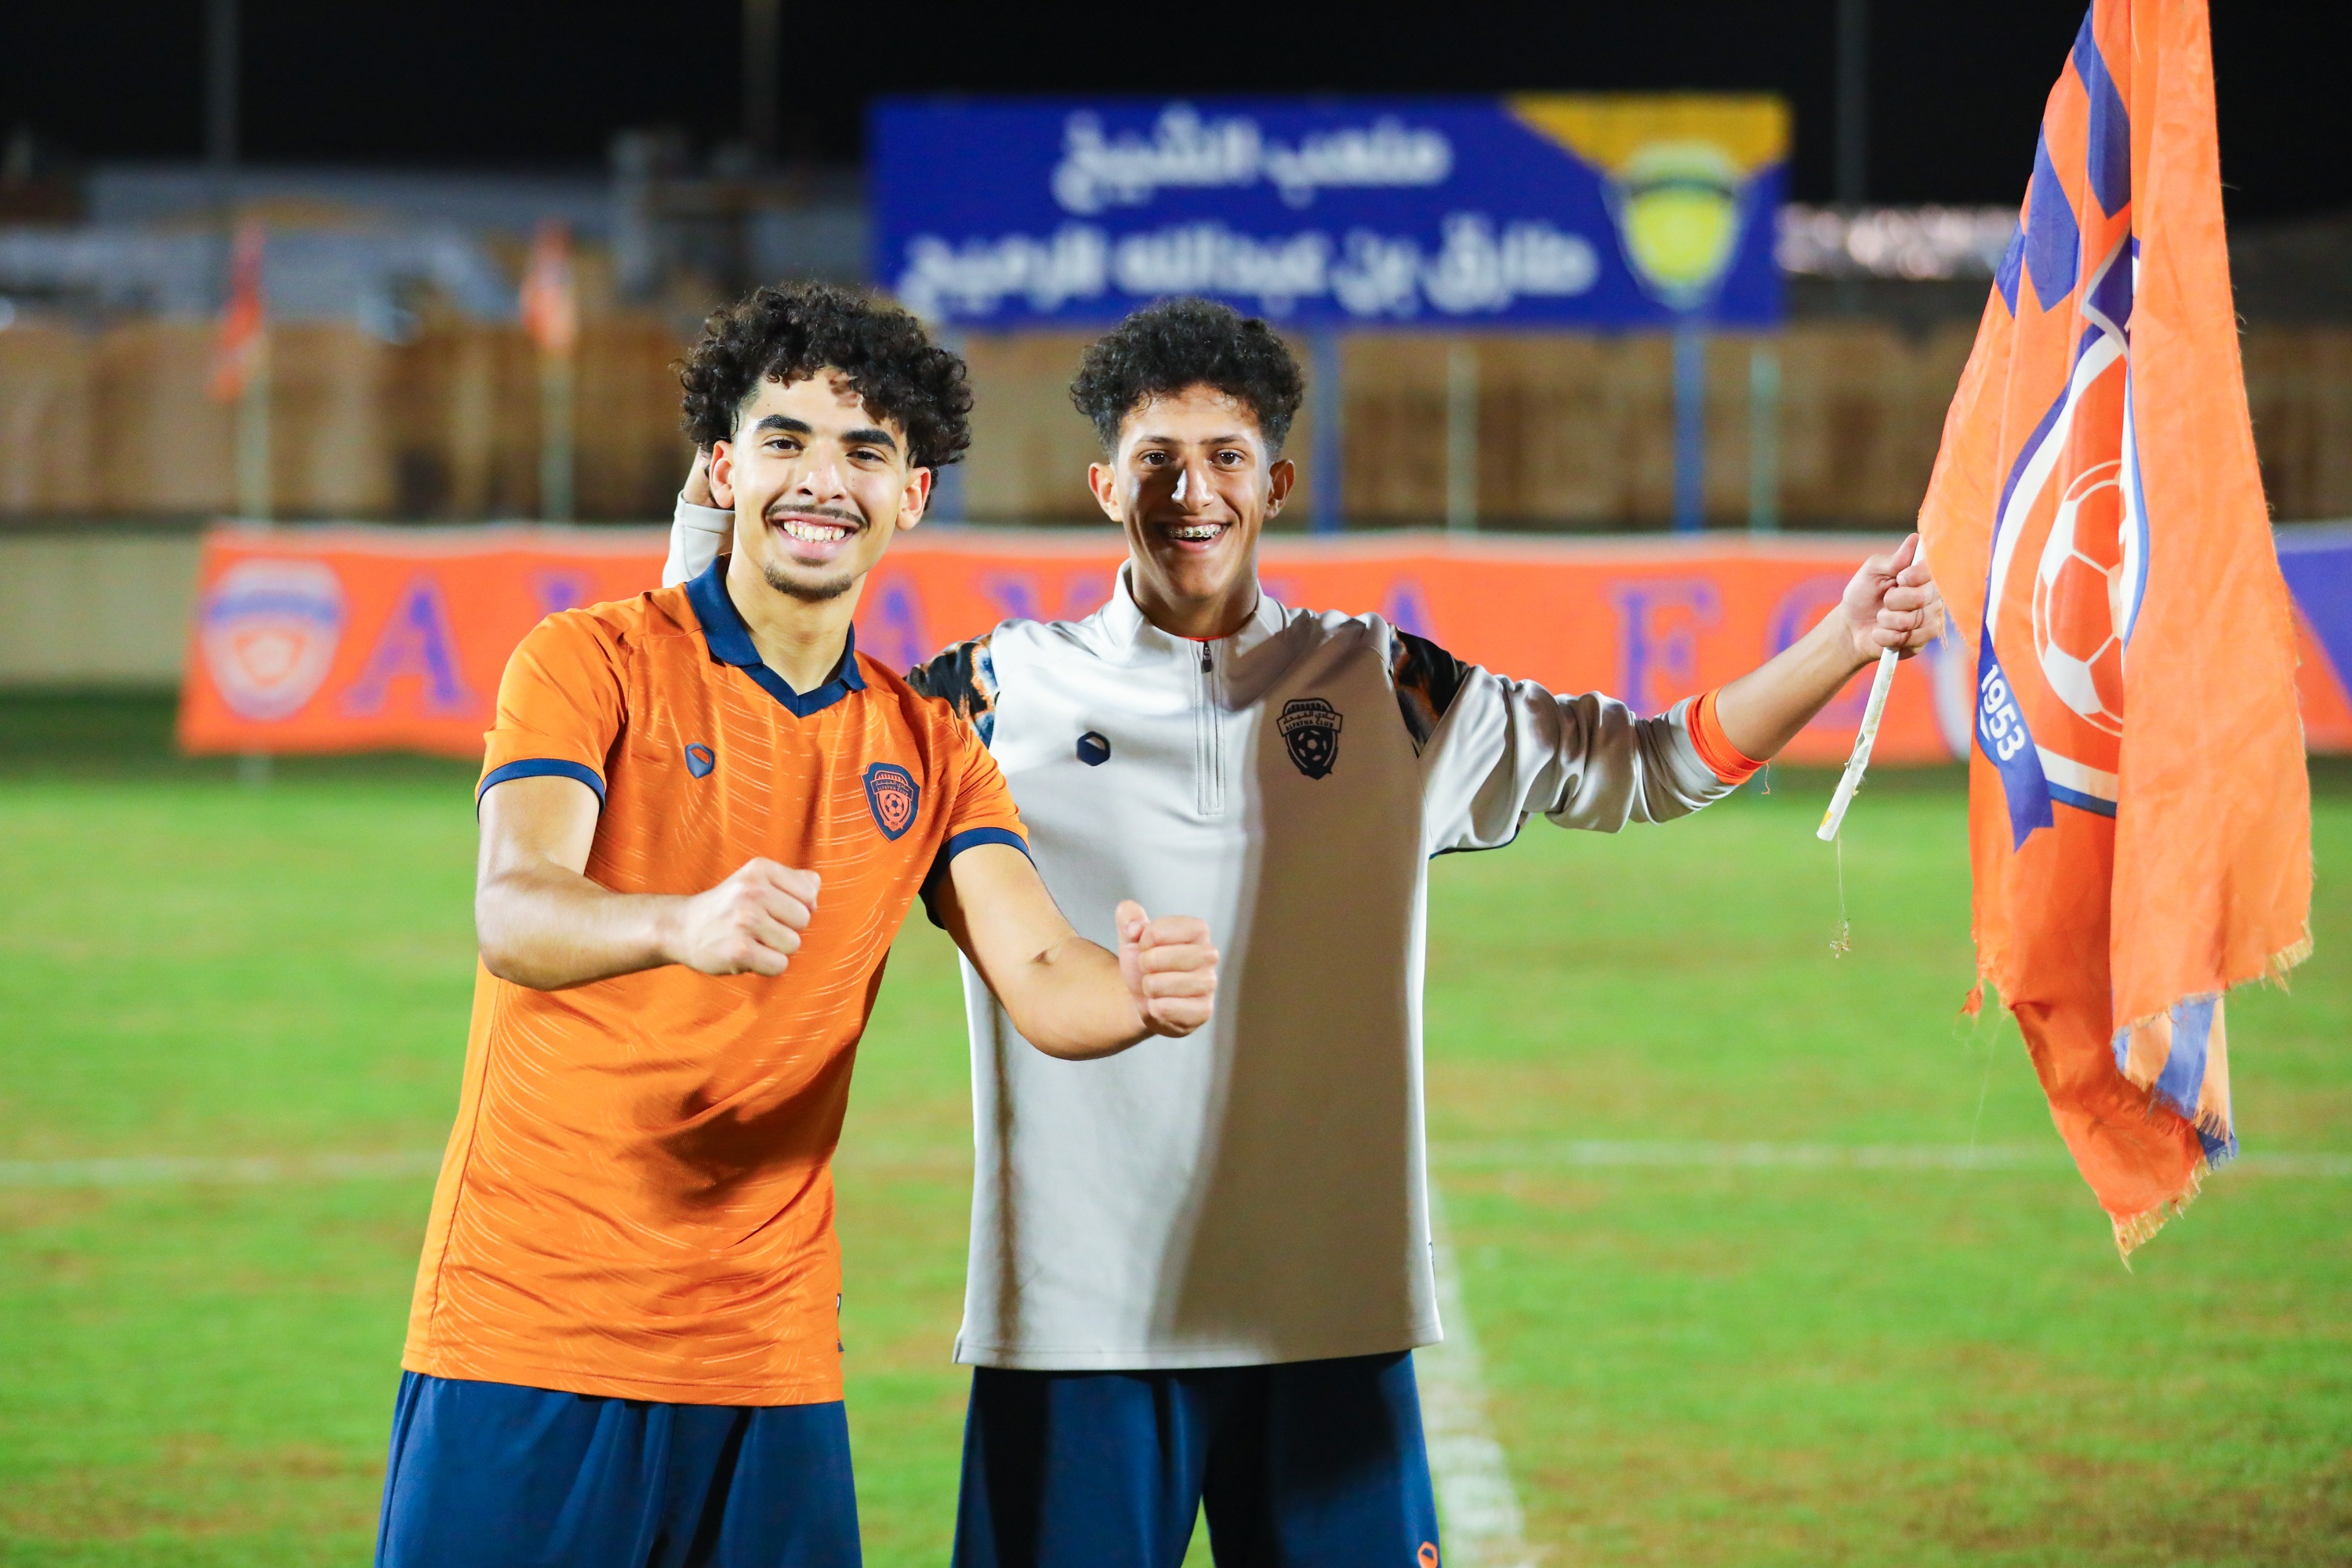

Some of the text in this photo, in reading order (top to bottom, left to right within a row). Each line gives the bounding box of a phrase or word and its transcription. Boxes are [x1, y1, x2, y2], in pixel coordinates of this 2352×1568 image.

[1057, 105, 1451, 213] ملعب الشيخ
[1335, 230, 1416, 315] بن
[1424, 215, 1596, 312] طارق
[1980, 664, 2025, 761] 1953
